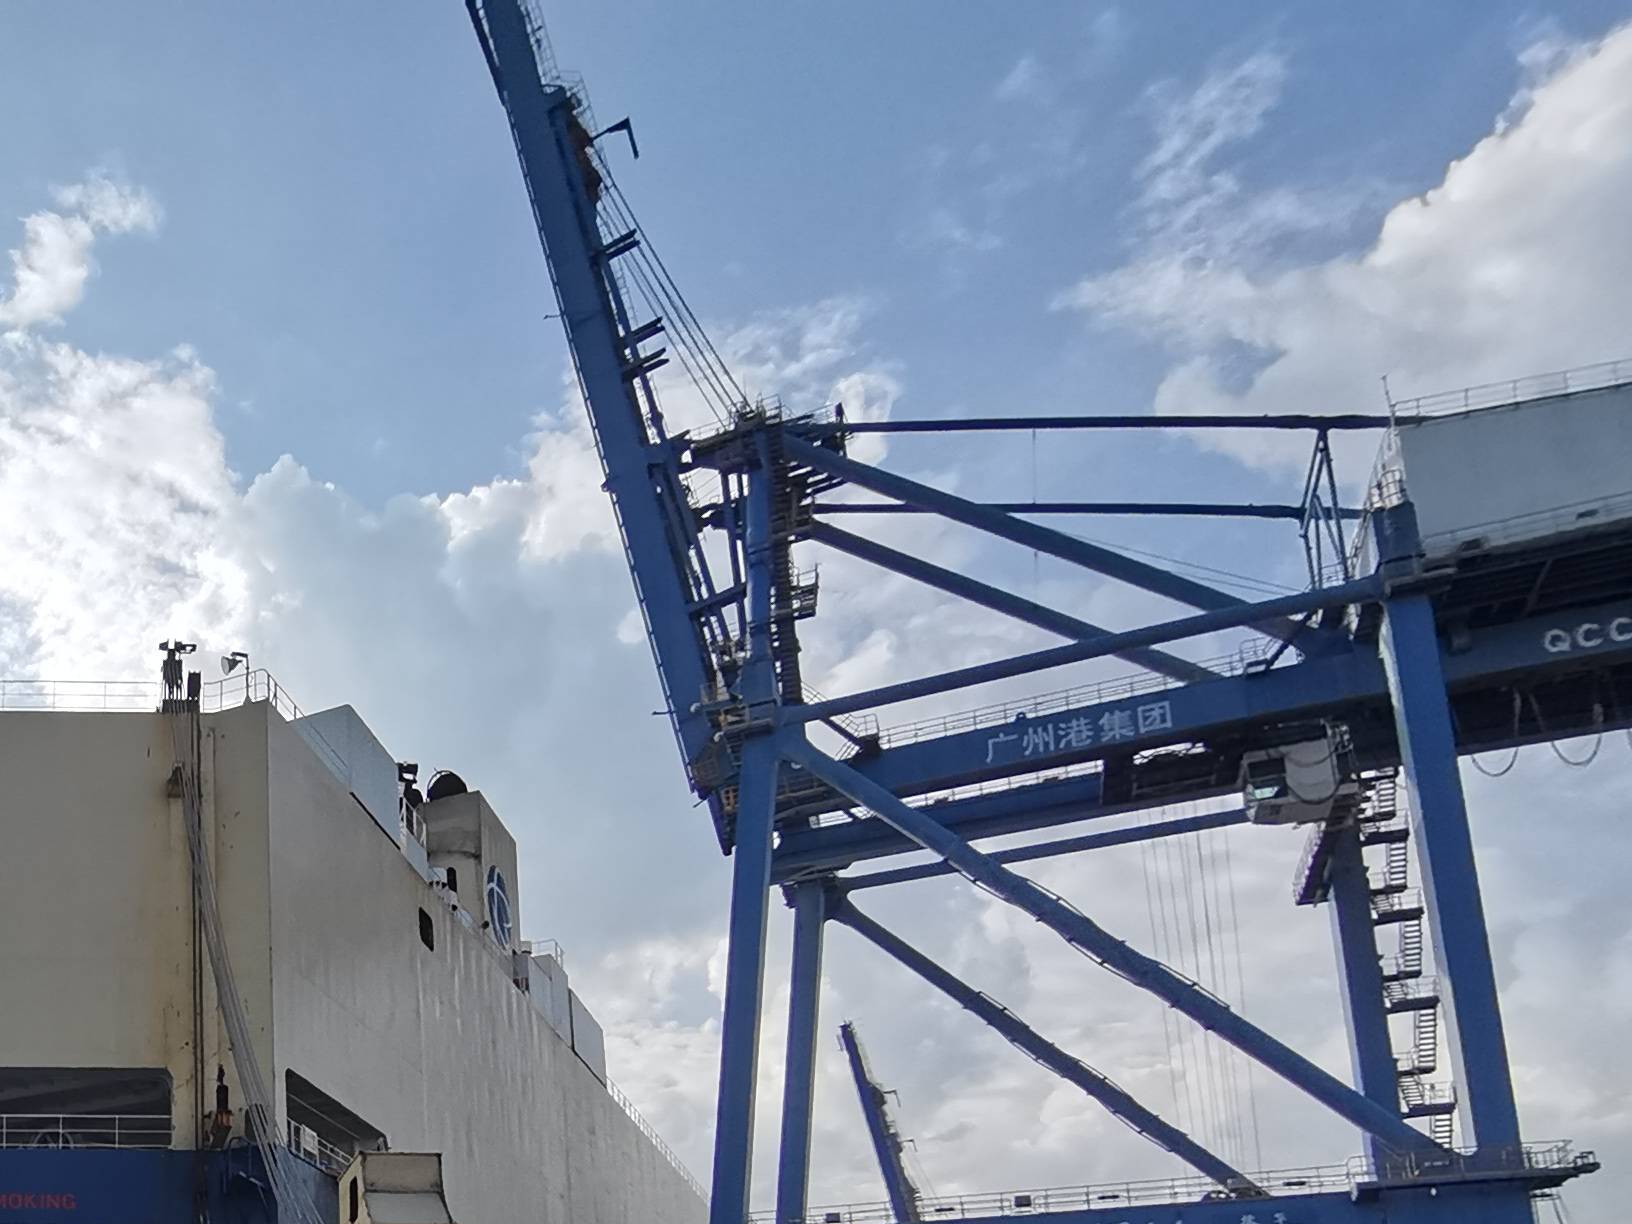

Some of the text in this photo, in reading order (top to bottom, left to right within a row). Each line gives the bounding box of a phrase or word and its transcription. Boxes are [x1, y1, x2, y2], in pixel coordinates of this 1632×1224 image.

[985, 701, 1173, 764] 广州港集团
